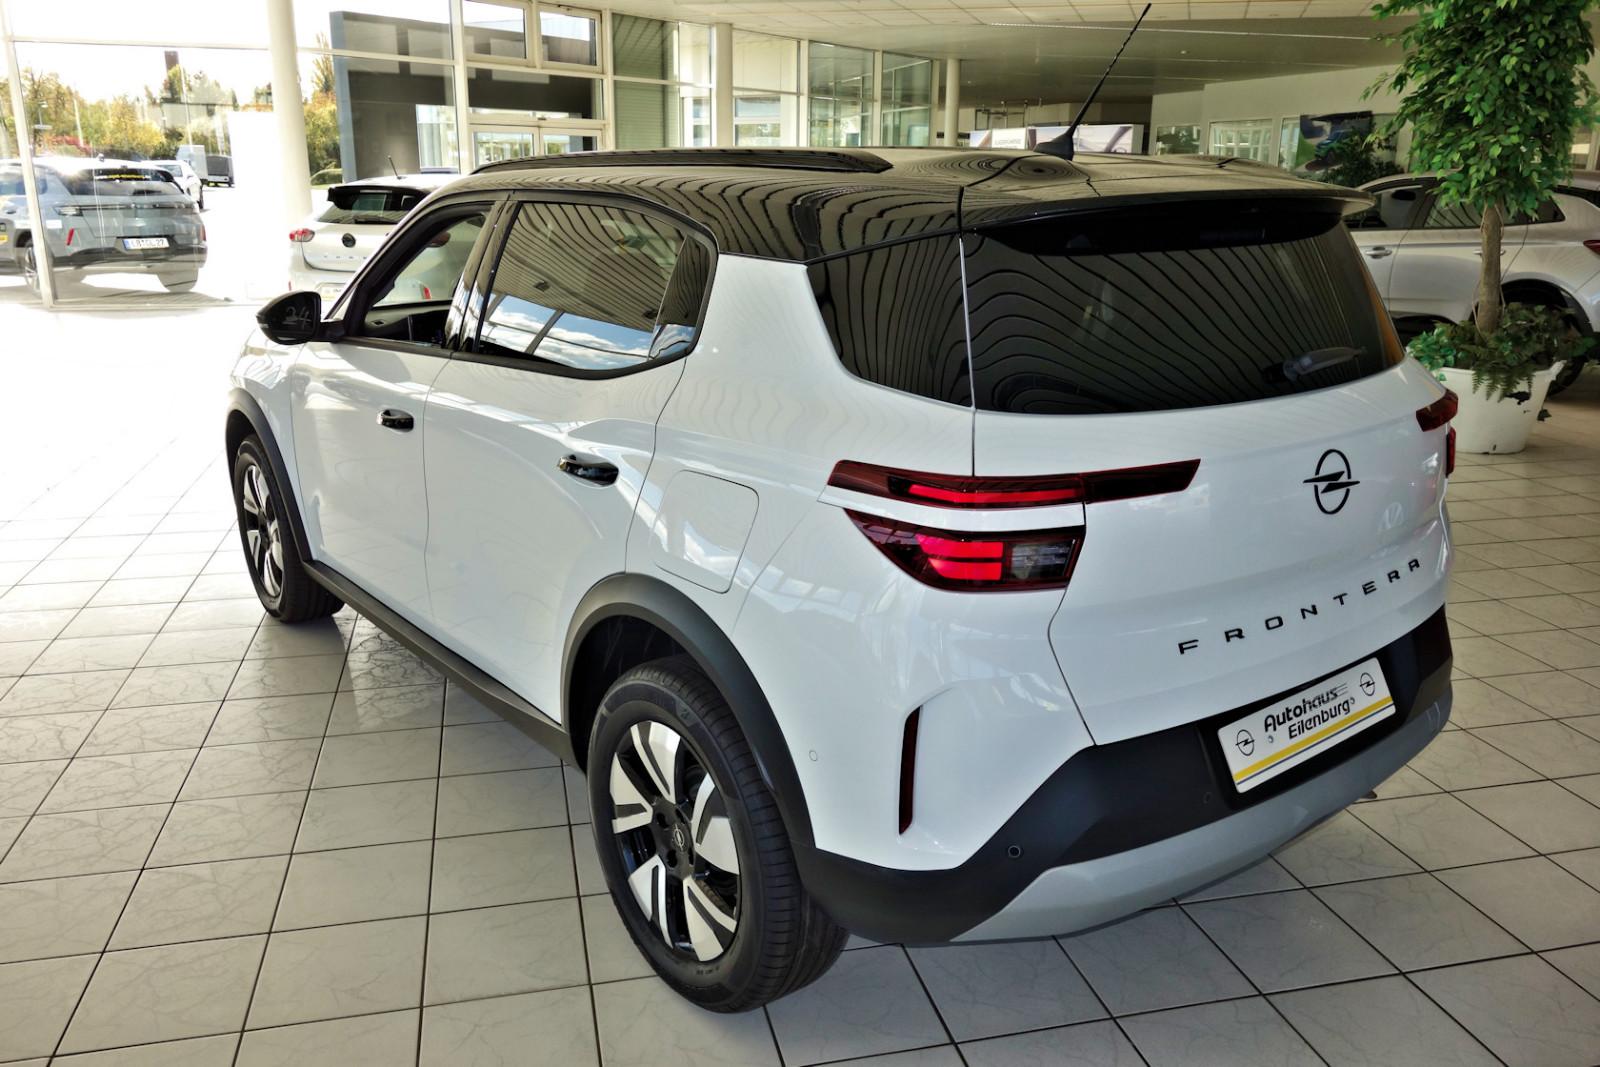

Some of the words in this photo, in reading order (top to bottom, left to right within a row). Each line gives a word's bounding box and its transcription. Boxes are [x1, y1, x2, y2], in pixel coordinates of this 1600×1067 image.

[1177, 558, 1421, 655] FRONTERA
[1264, 687, 1339, 732] Autohaus
[1288, 699, 1350, 739] Eilenburg
